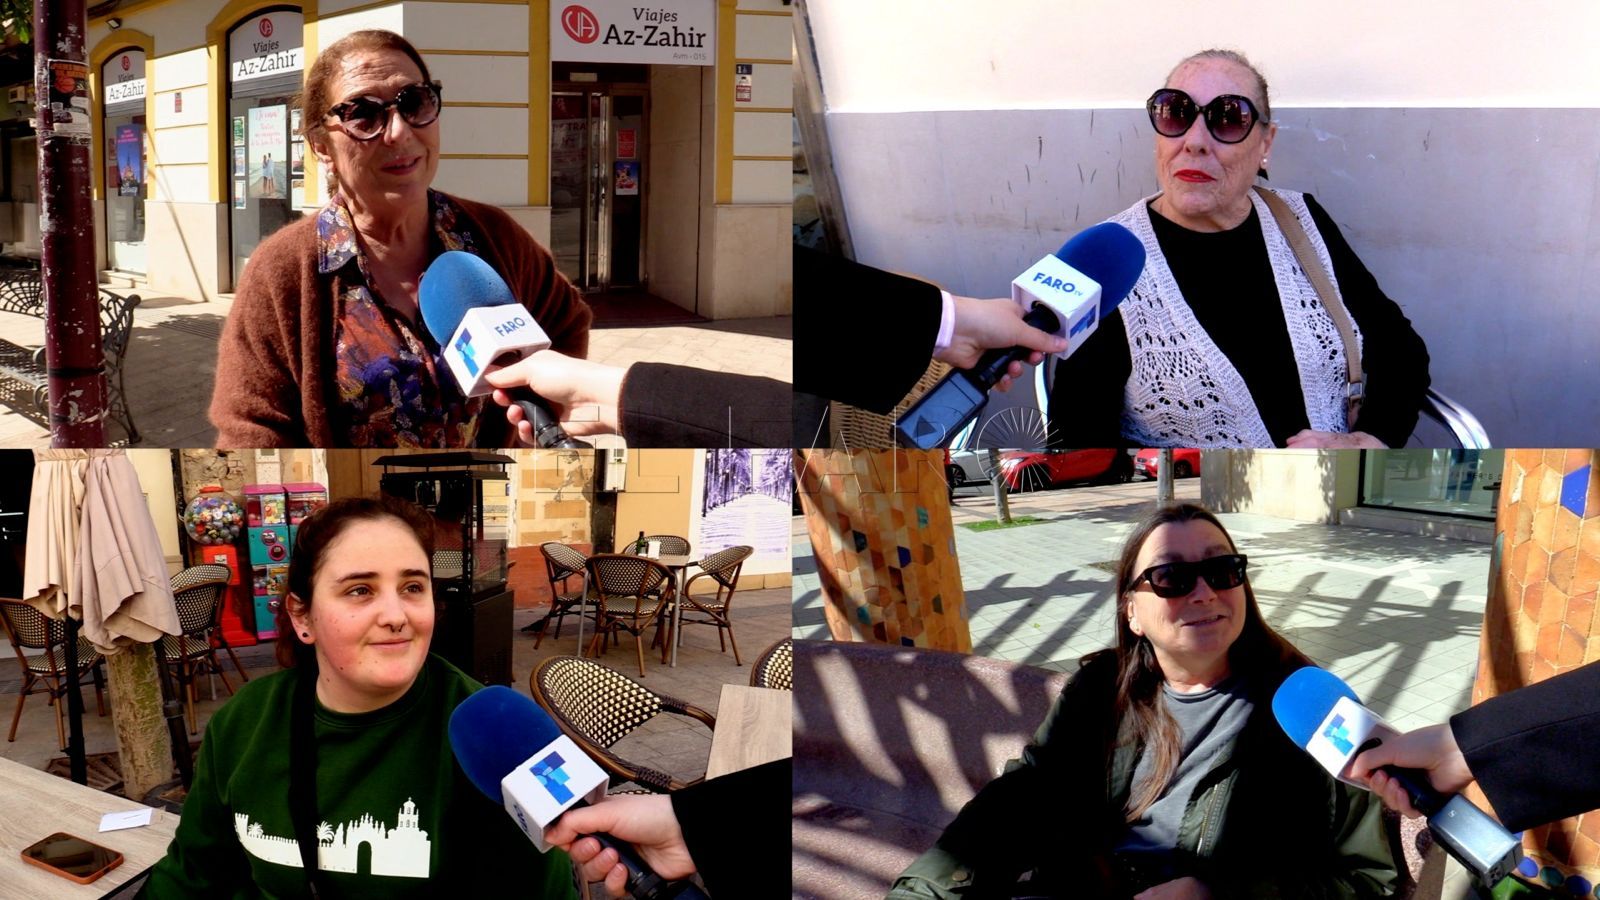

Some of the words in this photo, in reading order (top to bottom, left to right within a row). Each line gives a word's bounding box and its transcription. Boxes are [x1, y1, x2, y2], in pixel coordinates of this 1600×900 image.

[633, 7, 678, 24] Viajes
[602, 24, 706, 48] Az-Zahir
[253, 40, 279, 54] Viajes
[673, 52, 688, 60] Avm
[238, 50, 296, 77] Az-Zahir
[109, 82, 144, 101] Az-Zahir
[1033, 272, 1076, 293] FARO
[494, 316, 526, 337] FARO
